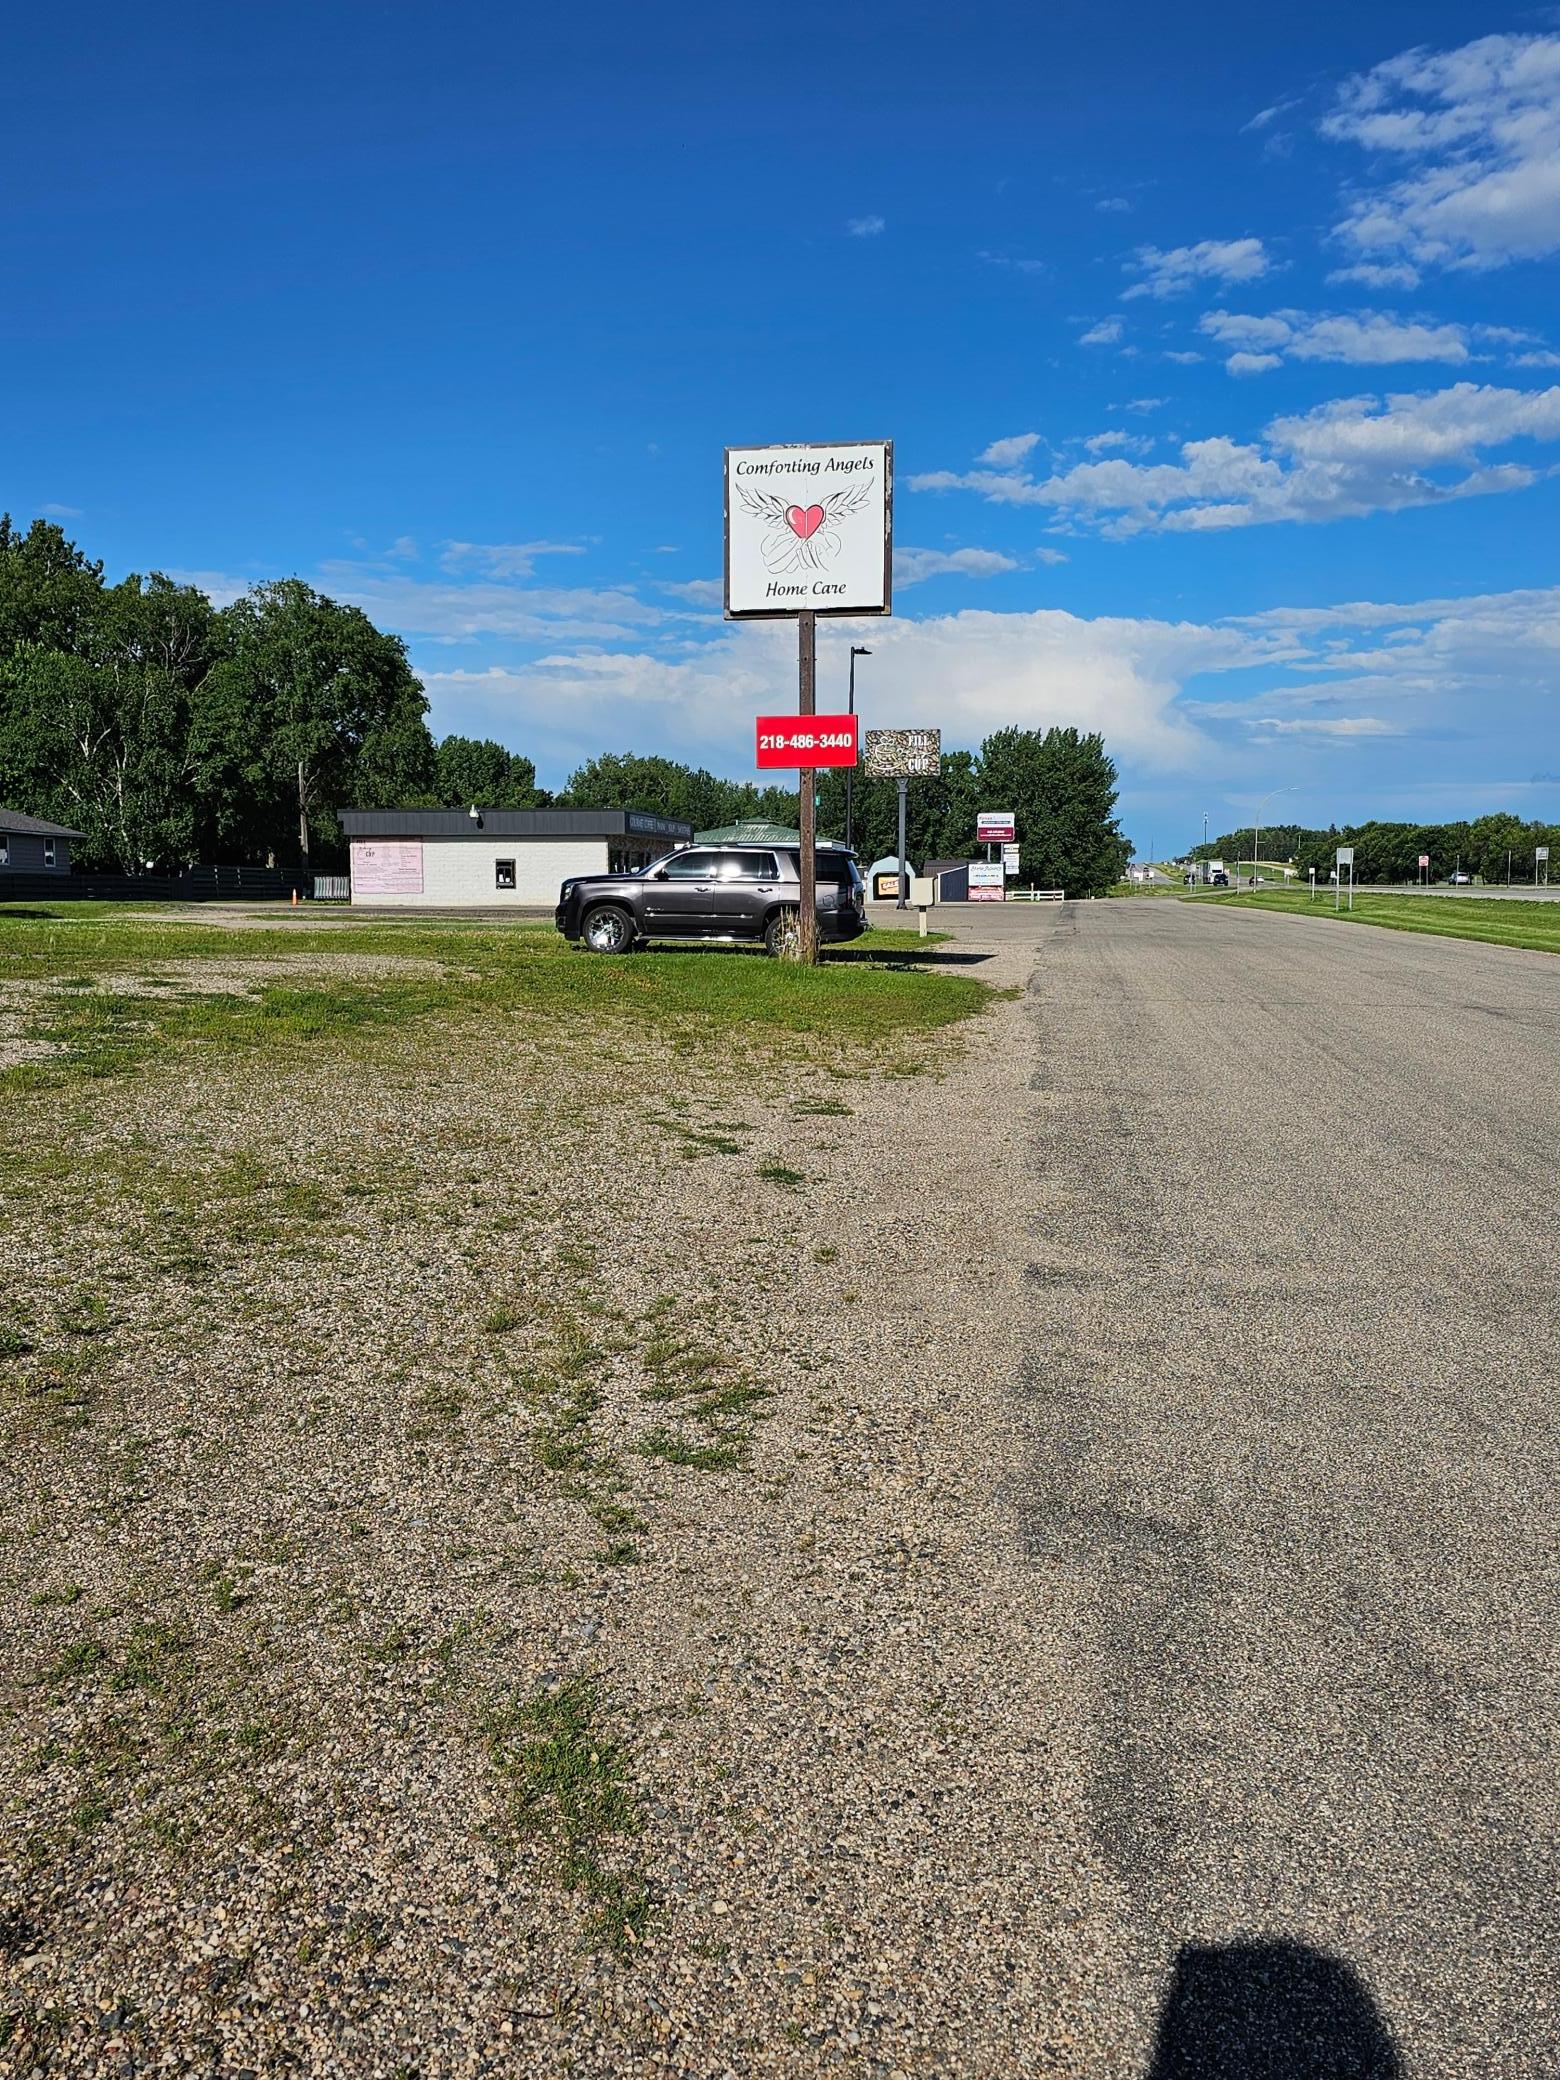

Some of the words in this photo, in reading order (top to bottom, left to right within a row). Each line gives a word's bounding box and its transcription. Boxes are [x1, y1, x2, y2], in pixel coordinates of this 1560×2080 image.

[736, 458, 820, 476] Comforting
[824, 456, 874, 475] Angels
[766, 582, 807, 597] Home
[812, 580, 846, 595] Care
[760, 733, 852, 749] 218-486-3440
[908, 735, 929, 746] FILL
[908, 758, 929, 770] CUP
